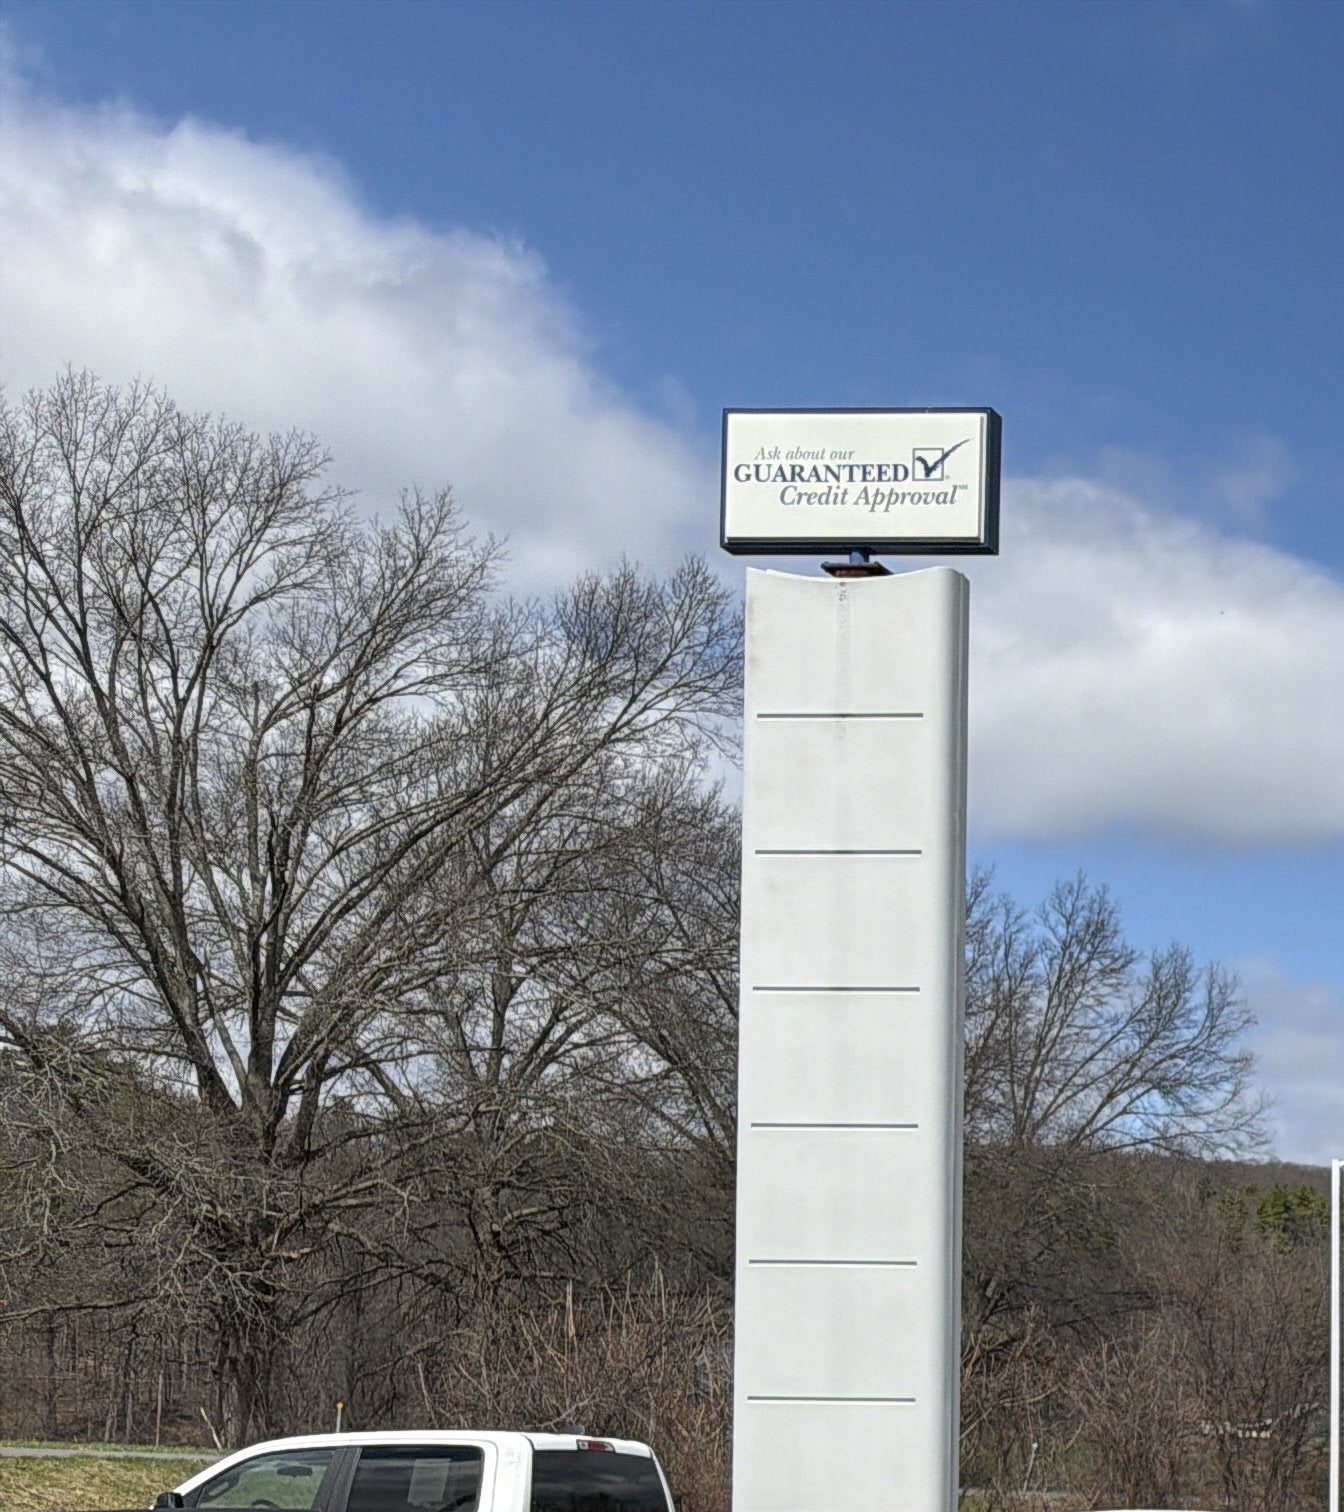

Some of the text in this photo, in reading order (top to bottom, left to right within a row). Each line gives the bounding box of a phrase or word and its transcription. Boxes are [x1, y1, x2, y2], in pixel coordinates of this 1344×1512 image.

[754, 447, 855, 460] Ask about our
[733, 464, 909, 483] GUARANTEED
[780, 485, 848, 506] Credit
